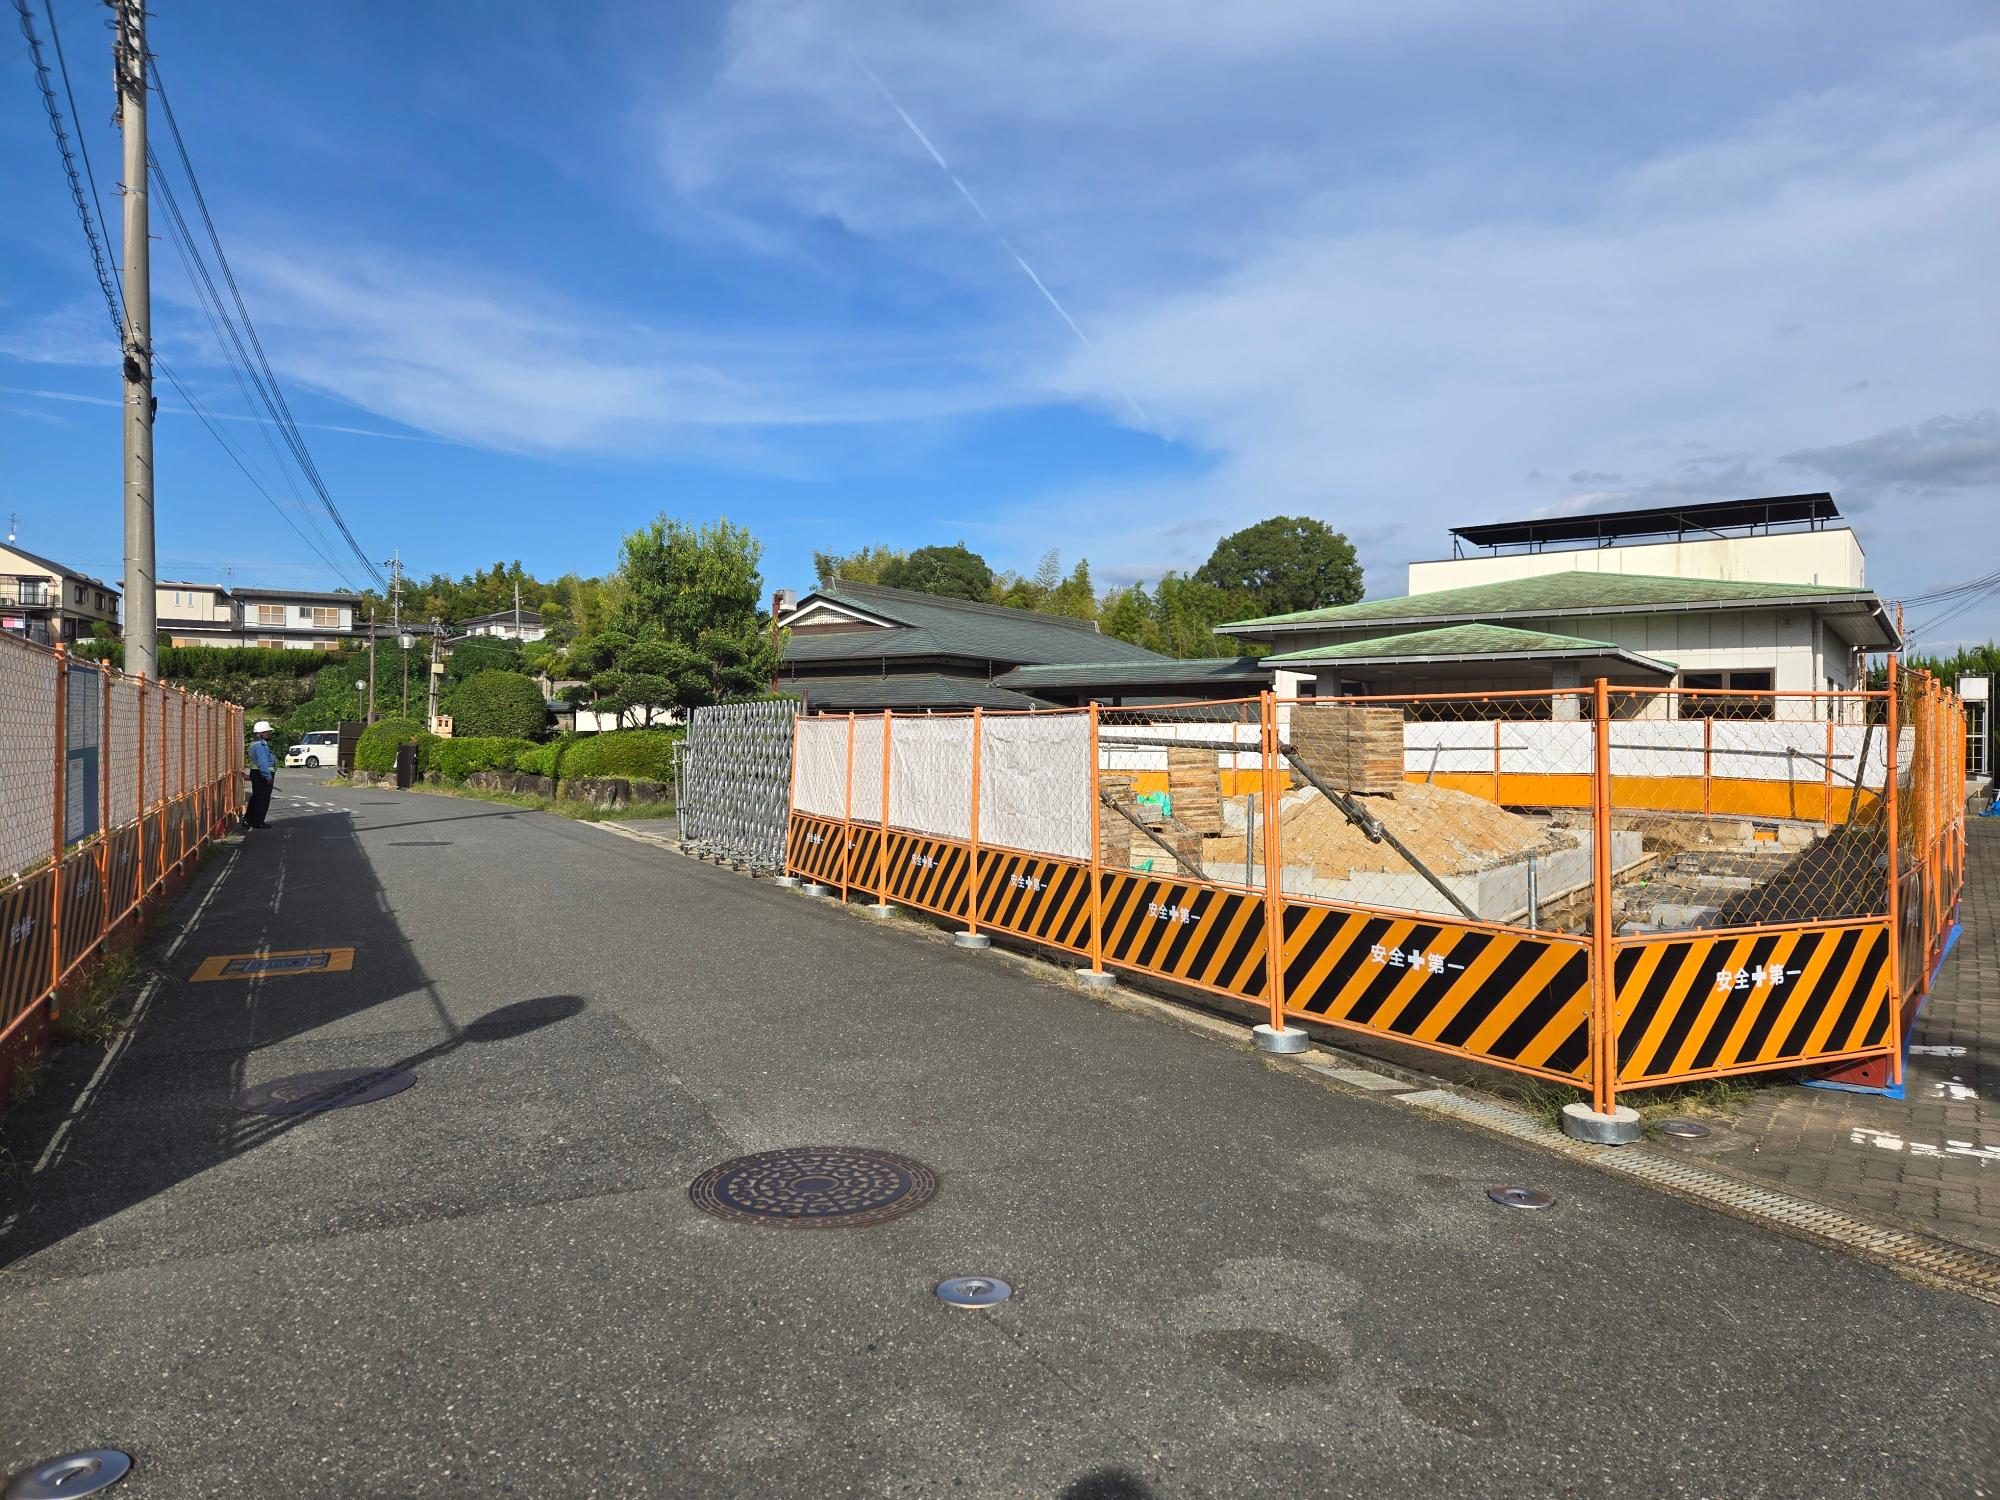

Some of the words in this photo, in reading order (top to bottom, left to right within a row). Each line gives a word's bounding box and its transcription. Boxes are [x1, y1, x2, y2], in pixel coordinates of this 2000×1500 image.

[1148, 901, 1201, 924] 安全第一
[1370, 943, 1465, 974] 安全第一
[1716, 963, 1802, 992] 安全第一
